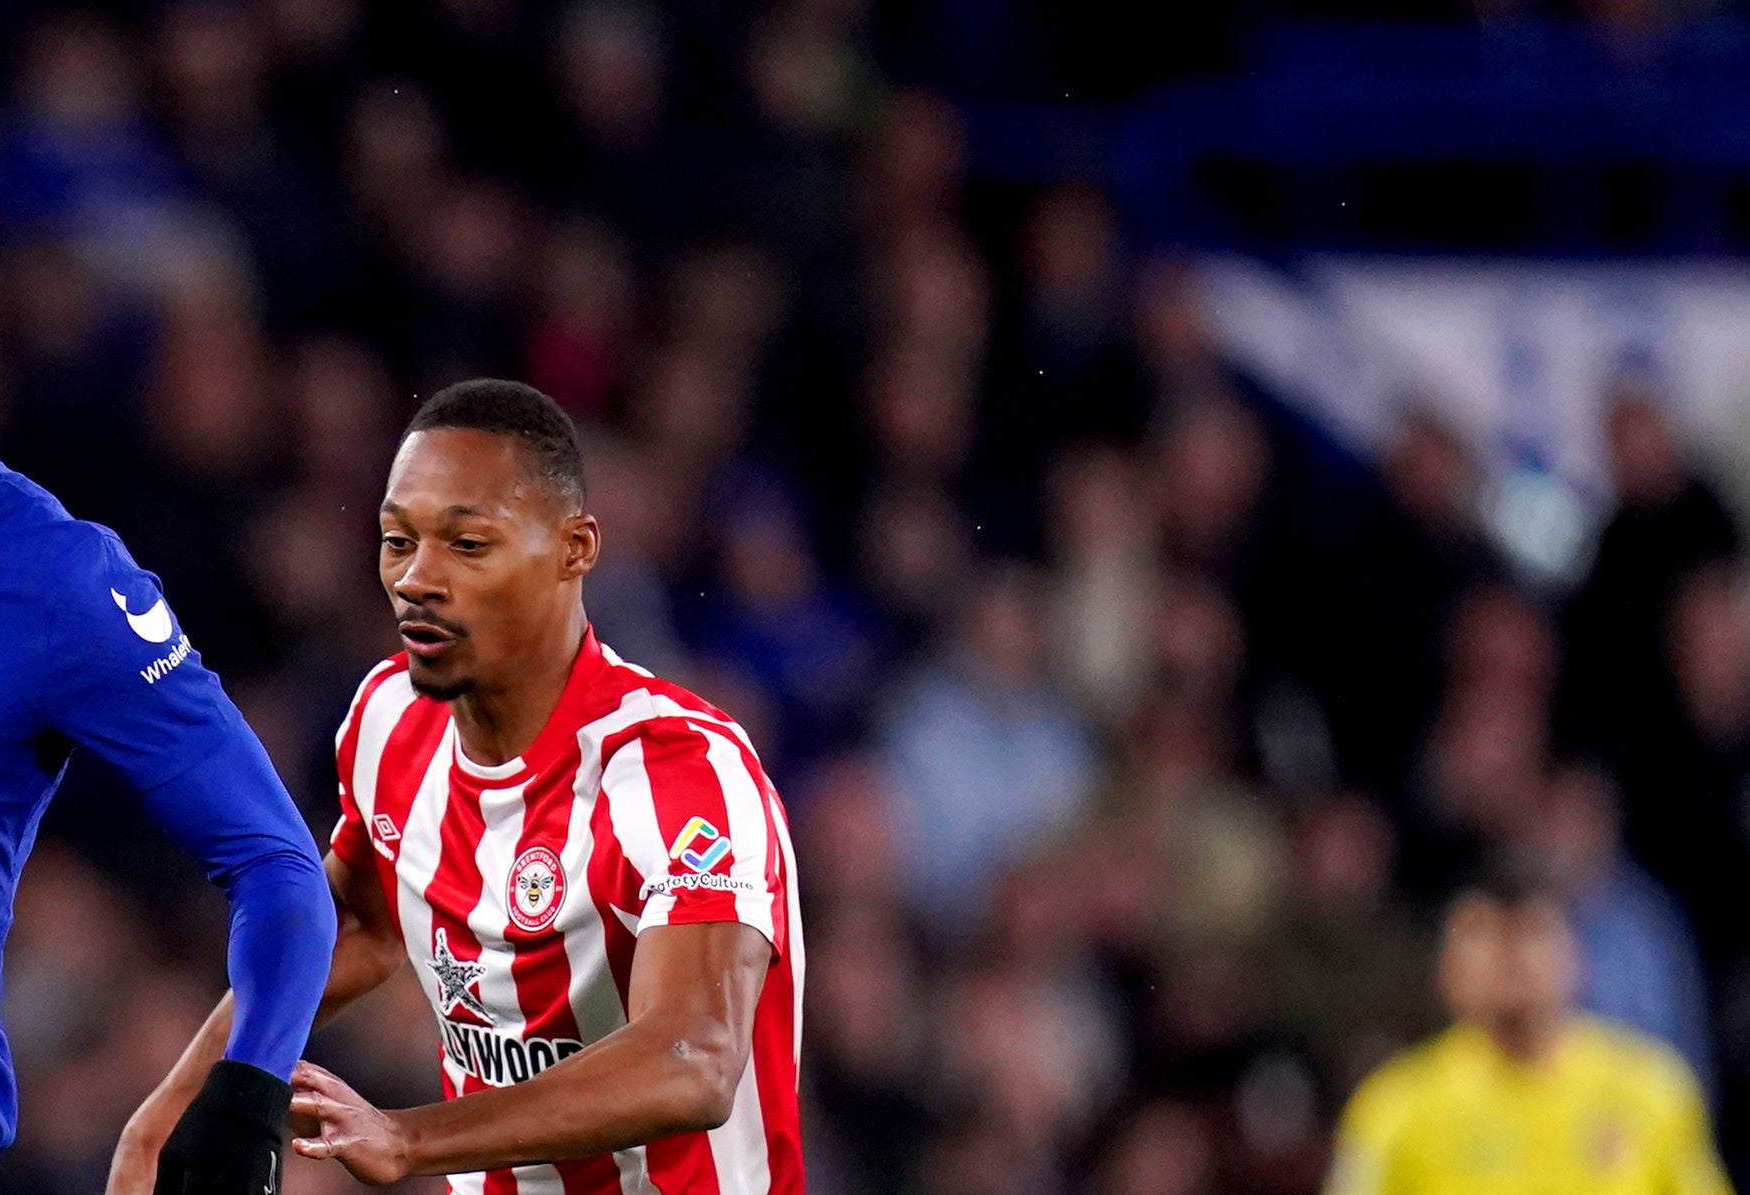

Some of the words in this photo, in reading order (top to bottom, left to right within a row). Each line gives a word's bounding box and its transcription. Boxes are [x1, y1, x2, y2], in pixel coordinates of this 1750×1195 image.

[516, 851, 558, 872] BRENTFORD
[512, 905, 540, 926] FOOTBALL
[540, 906, 556, 923] CLUB
